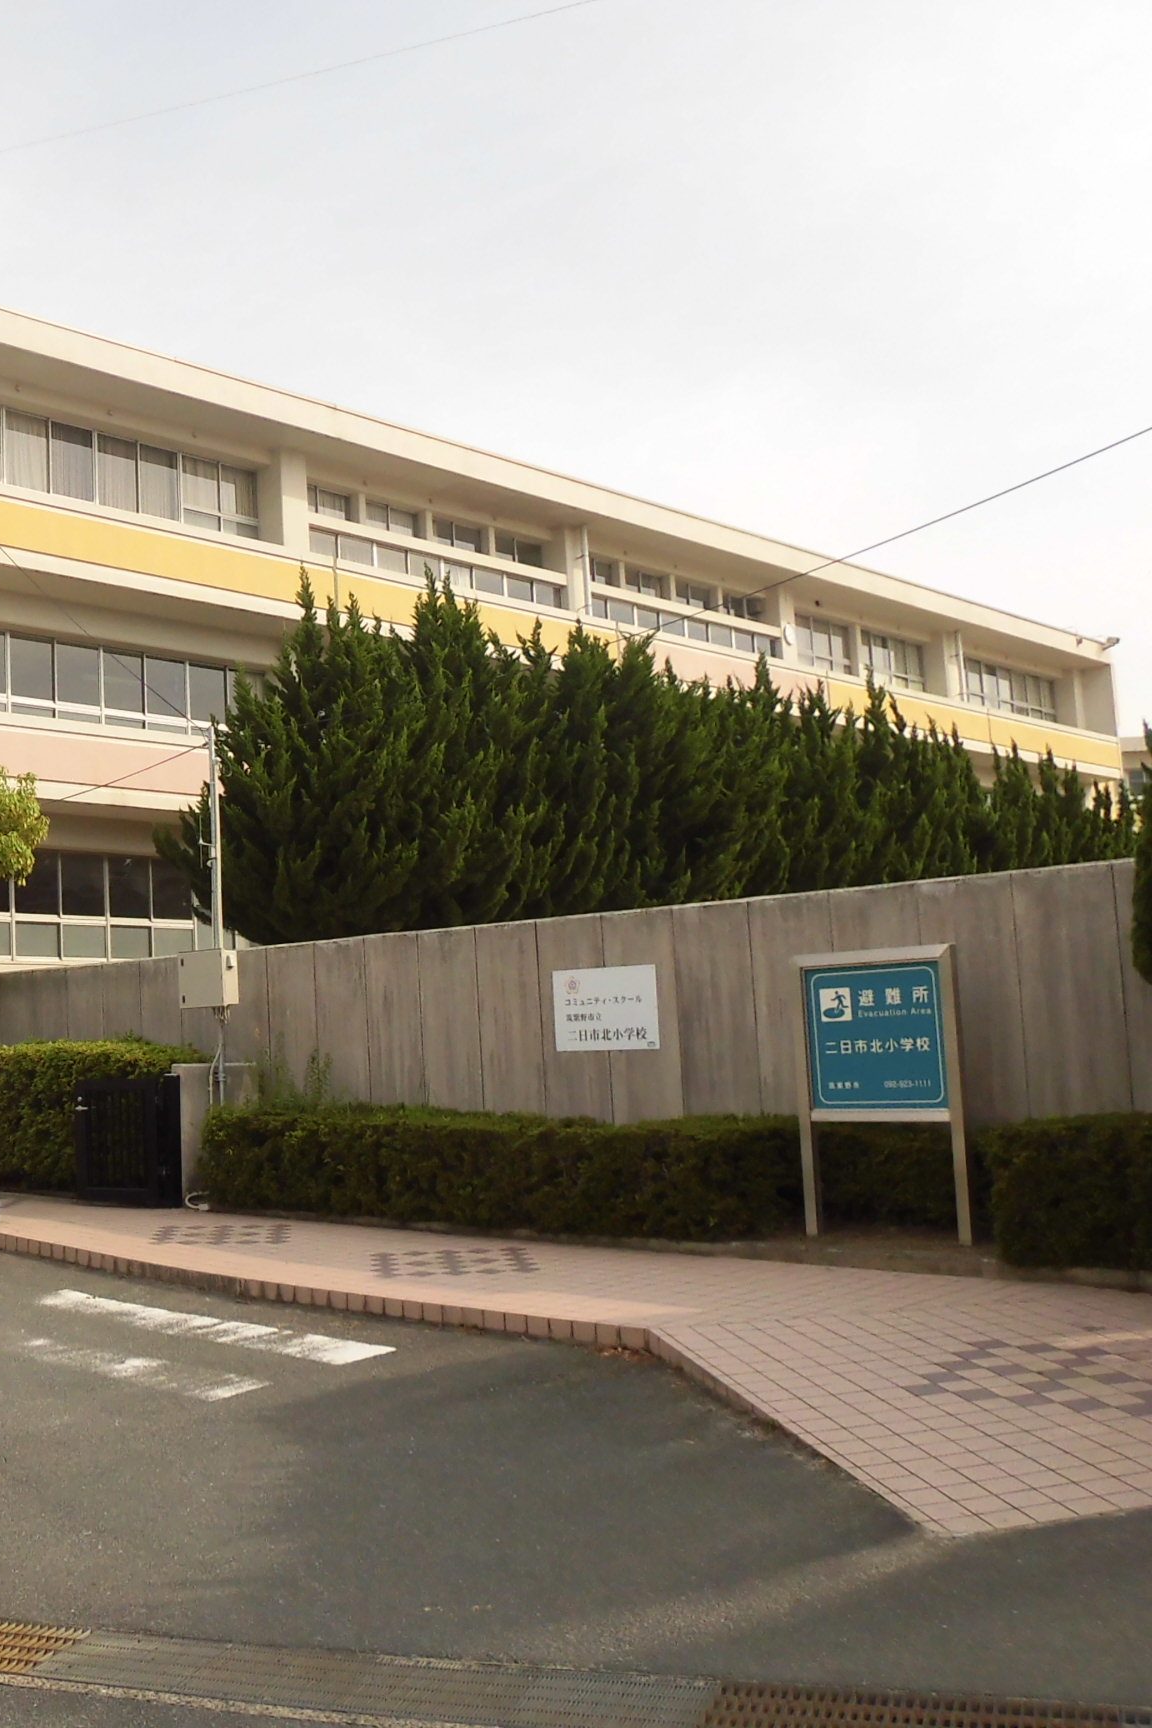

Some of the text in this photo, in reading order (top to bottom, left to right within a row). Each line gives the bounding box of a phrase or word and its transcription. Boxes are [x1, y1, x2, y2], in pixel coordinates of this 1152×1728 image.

[565, 995, 643, 1006] コミュニティ・スクール
[858, 986, 929, 1007] 避難所
[858, 1007, 932, 1018] Evacuation Area
[568, 1027, 648, 1042] 二日市北小学校
[825, 1037, 931, 1054] 二日市北小学校
